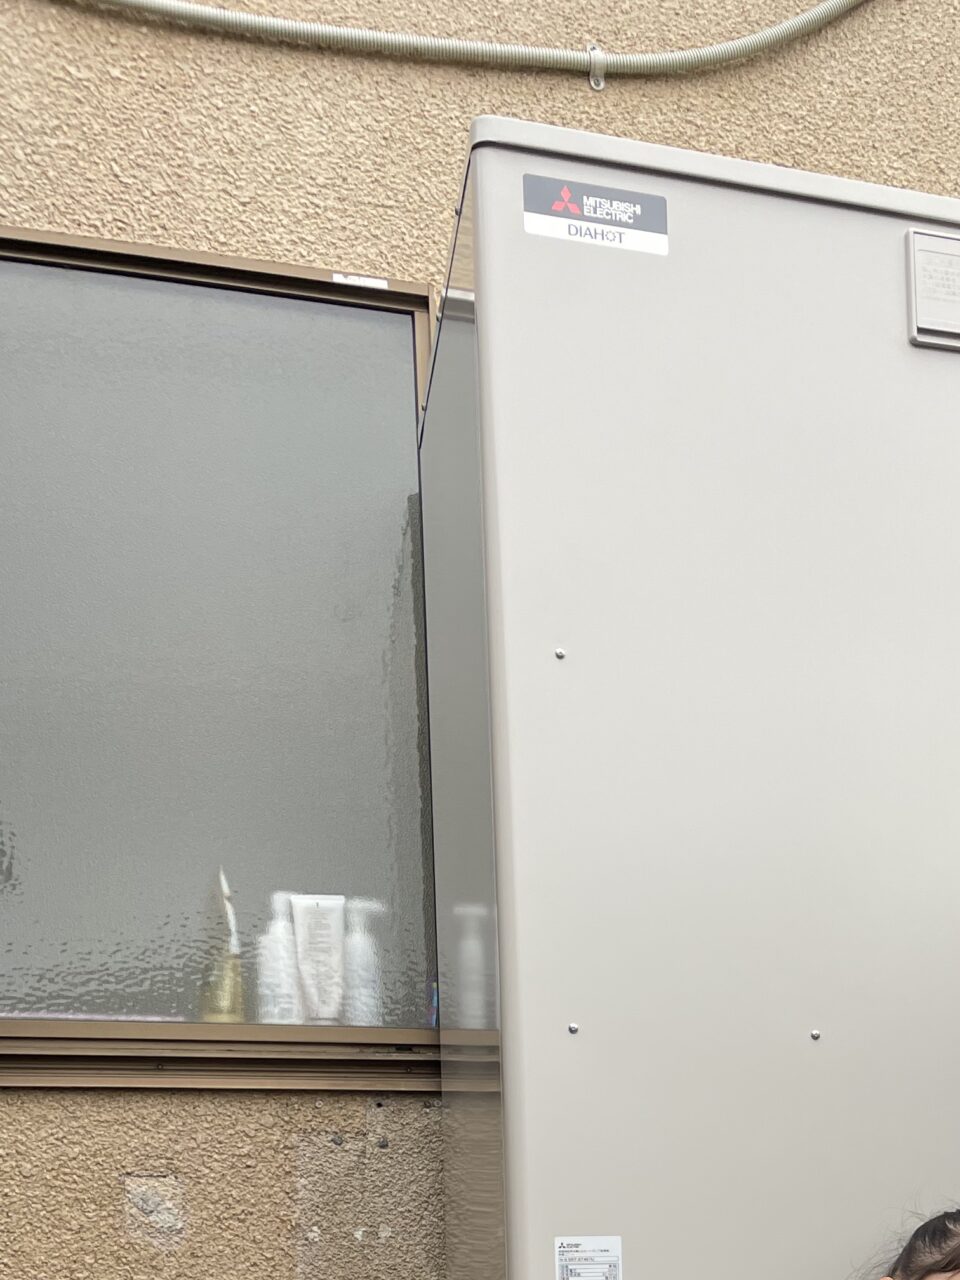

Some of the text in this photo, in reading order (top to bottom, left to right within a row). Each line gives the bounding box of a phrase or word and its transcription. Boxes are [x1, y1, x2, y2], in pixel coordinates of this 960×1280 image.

[583, 195, 642, 215] MITSUBISHI
[583, 205, 634, 224] ELECTRIC
[567, 224, 626, 243] DIAHOT
